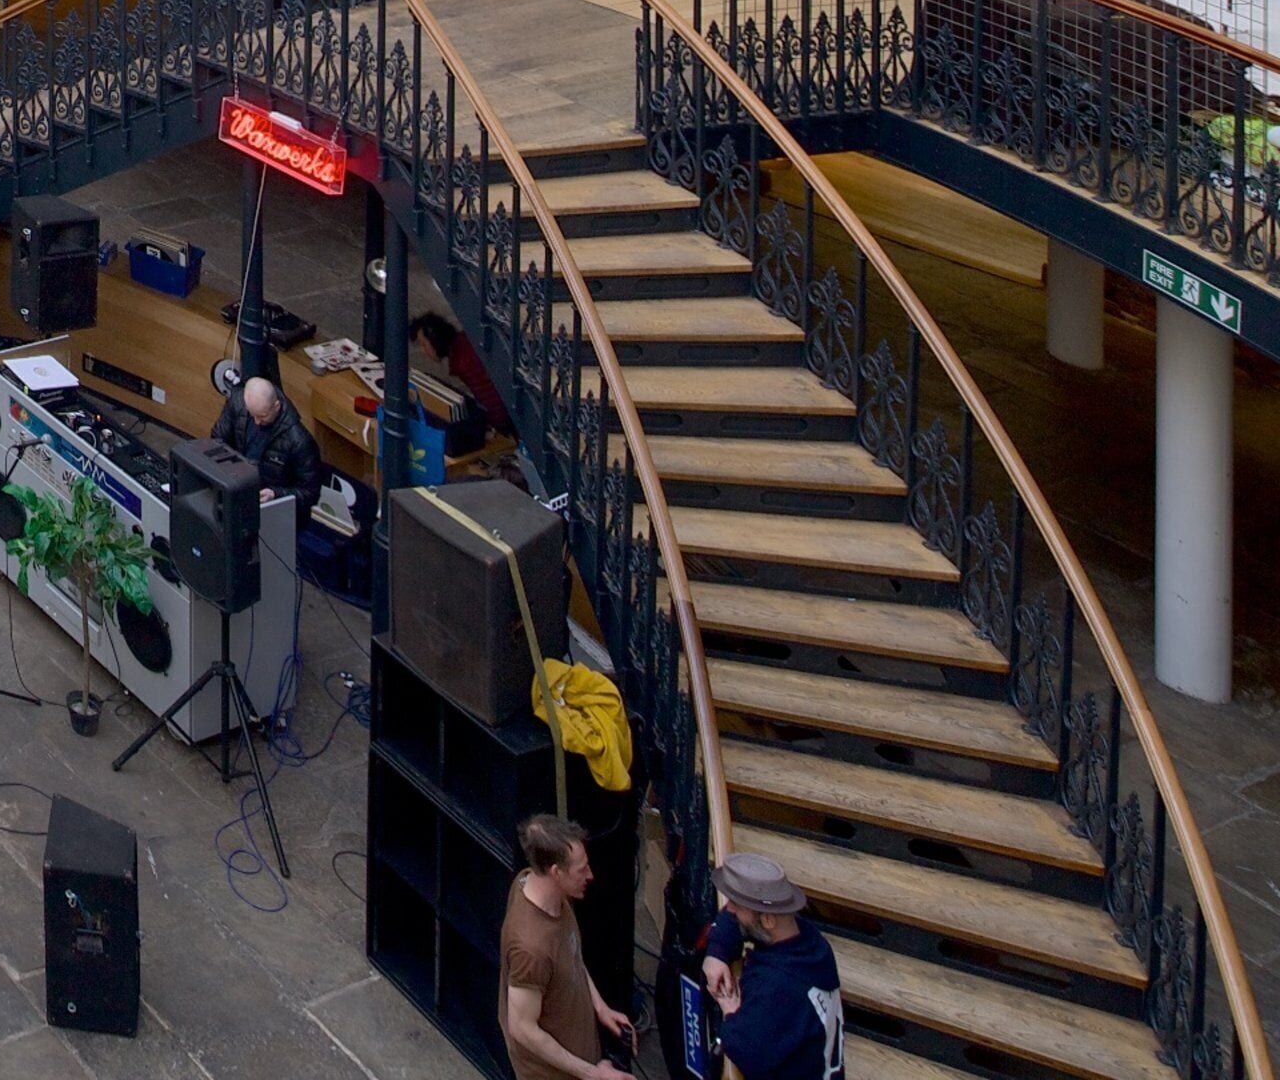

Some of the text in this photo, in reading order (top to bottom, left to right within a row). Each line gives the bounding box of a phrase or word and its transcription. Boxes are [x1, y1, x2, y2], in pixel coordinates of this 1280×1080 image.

[1149, 270, 1174, 290] EXIT
[1150, 258, 1174, 280] FIRE
[684, 987, 696, 1063] ENTRY
[692, 1012, 701, 1048] NO
